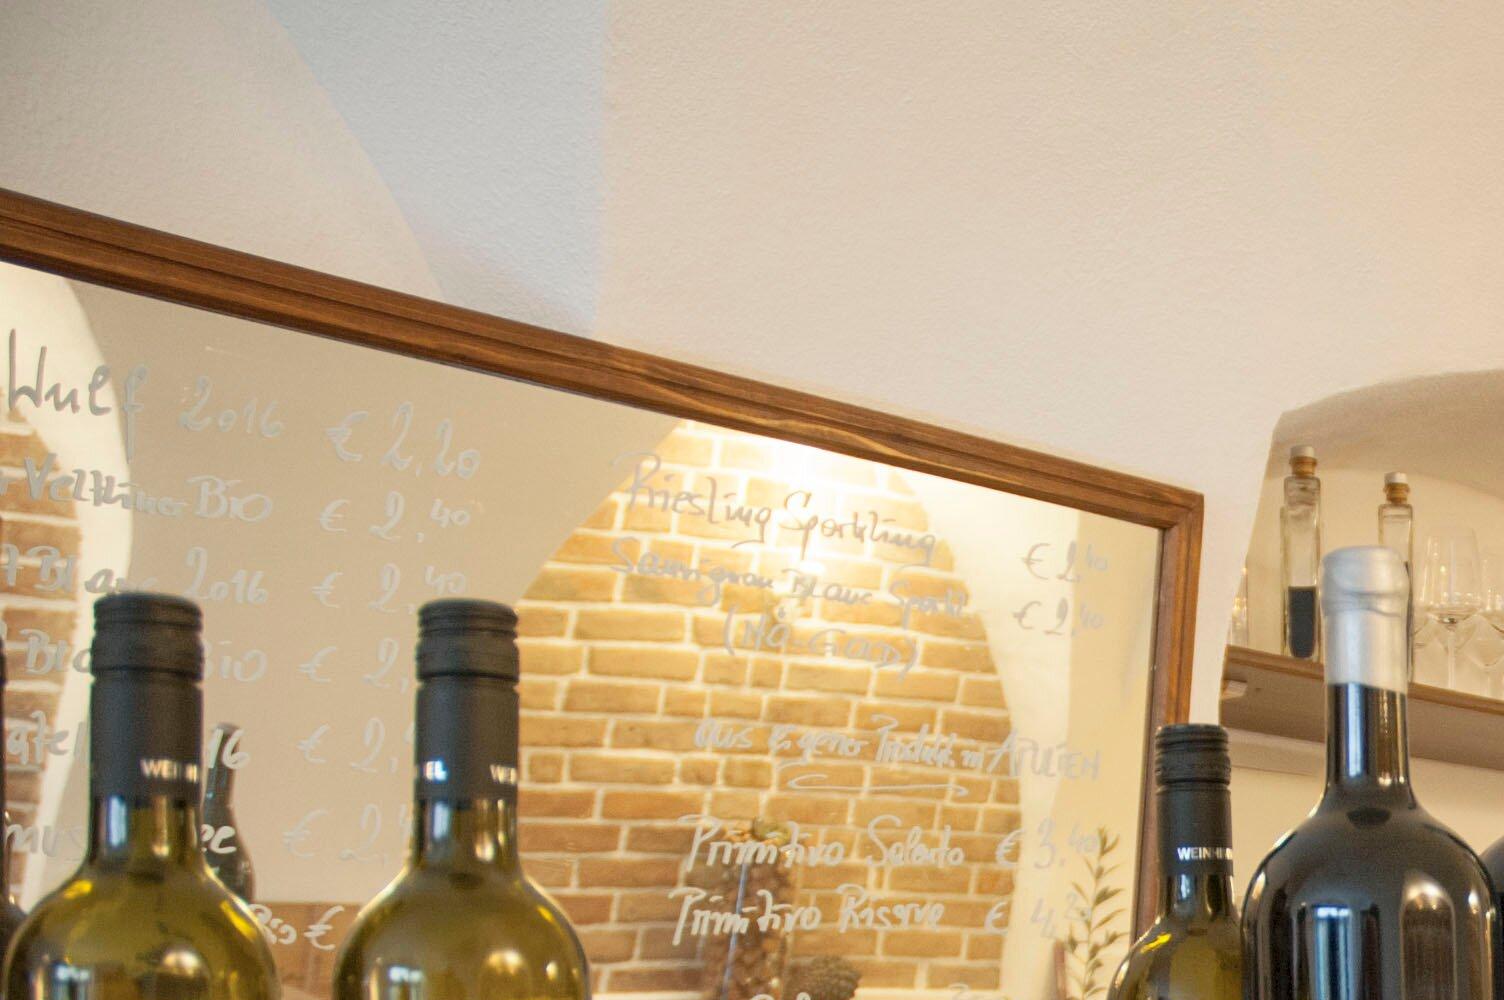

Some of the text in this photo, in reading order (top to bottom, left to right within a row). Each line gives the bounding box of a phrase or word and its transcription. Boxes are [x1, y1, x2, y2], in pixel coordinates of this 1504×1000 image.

[178, 376, 284, 438] 2016
[326, 411, 369, 462] €
[319, 499, 350, 532] €
[611, 451, 771, 549] Riesling
[1022, 542, 1051, 580] €
[312, 571, 343, 609] €
[1012, 600, 1042, 630] €
[994, 829, 1026, 868] €
[304, 905, 345, 950] €
[984, 901, 1010, 935] €
